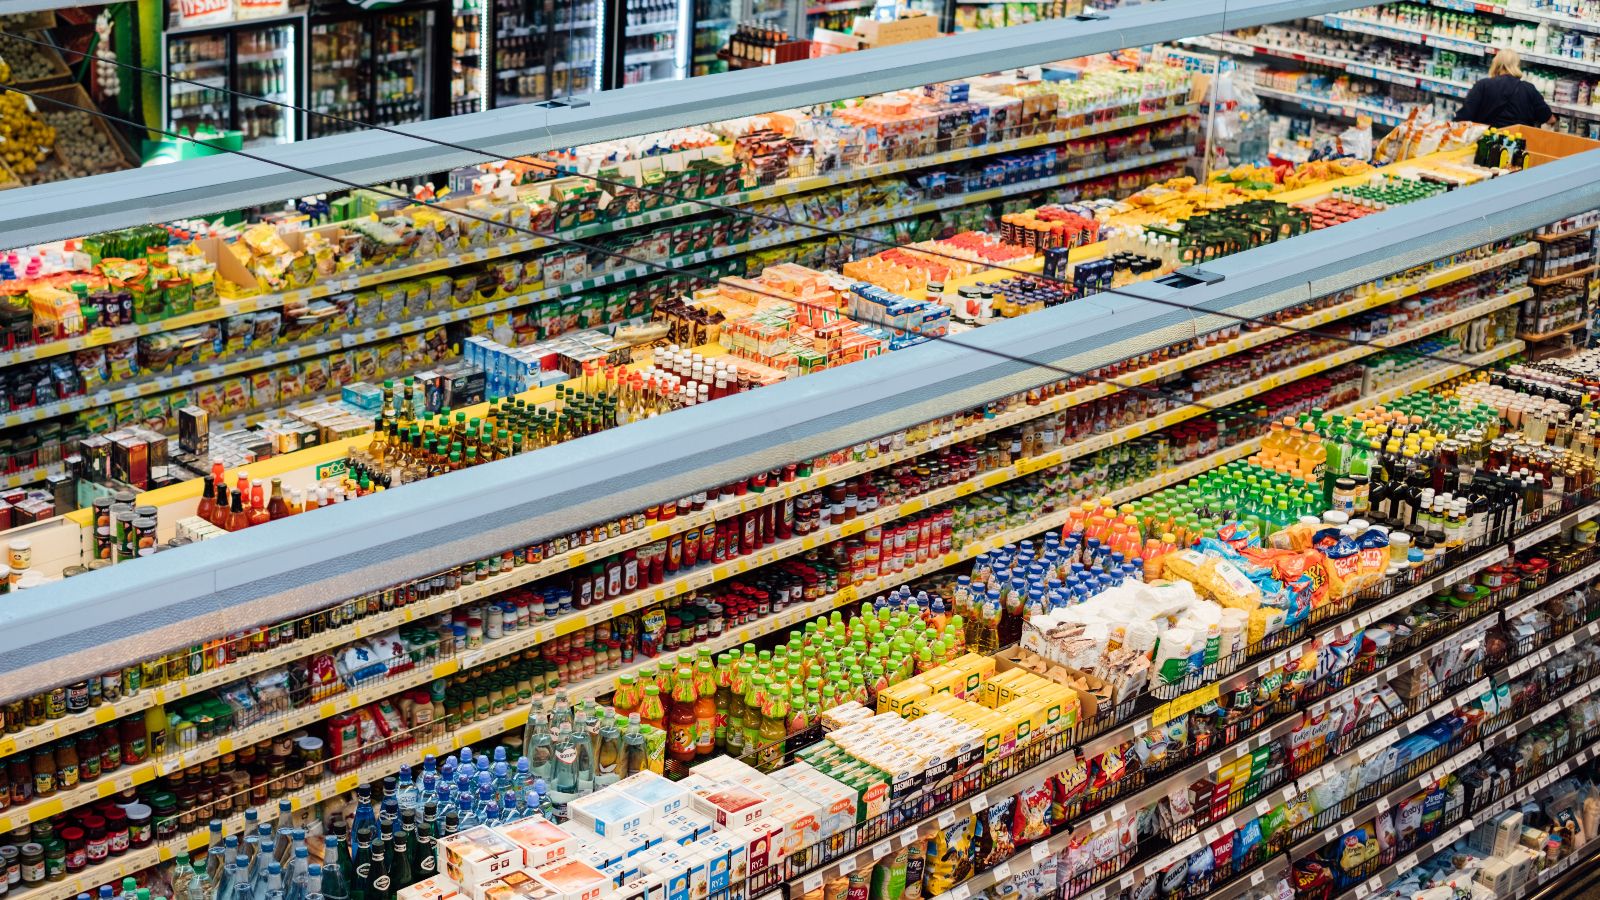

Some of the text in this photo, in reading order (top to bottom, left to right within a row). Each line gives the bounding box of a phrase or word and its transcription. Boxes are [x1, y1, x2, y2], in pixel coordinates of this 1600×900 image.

[1359, 548, 1382, 560] orn
[1334, 555, 1359, 569] corn
[1214, 841, 1234, 855] mues
[751, 857, 764, 871] RYŻ
[712, 876, 724, 889] RYŻ
[848, 888, 865, 897] afle
